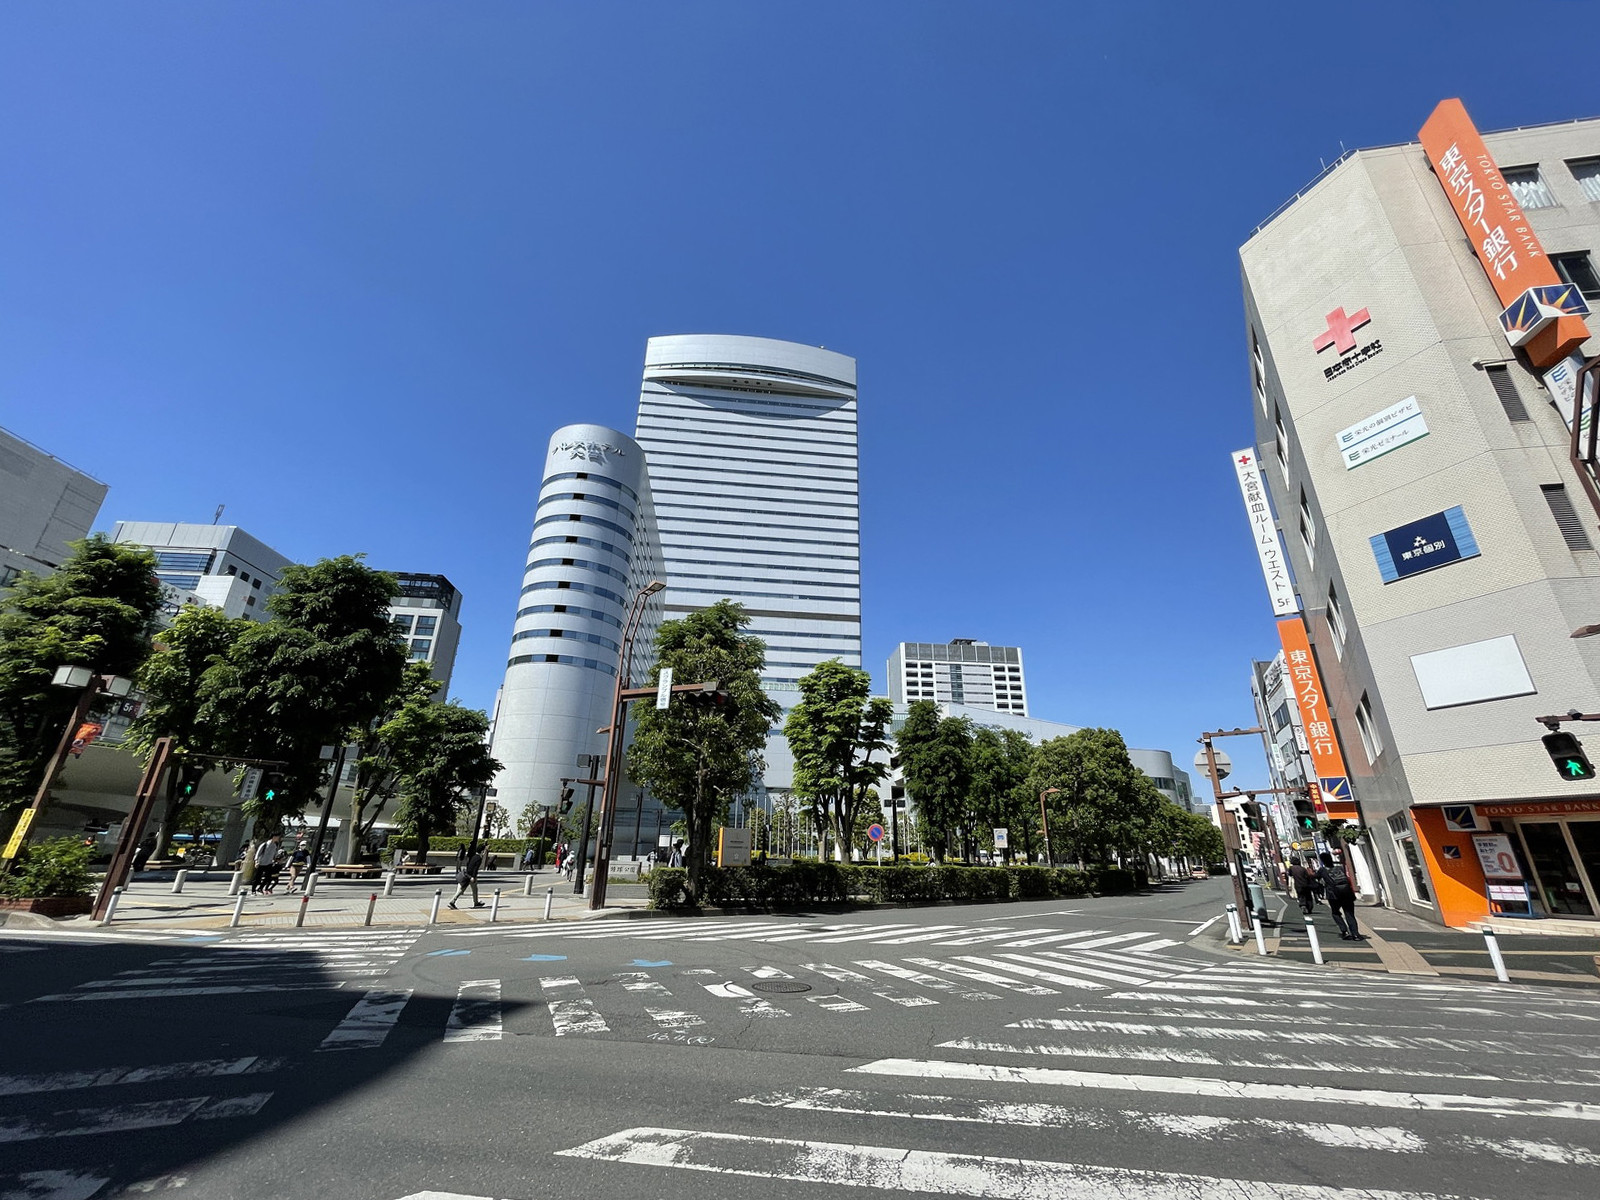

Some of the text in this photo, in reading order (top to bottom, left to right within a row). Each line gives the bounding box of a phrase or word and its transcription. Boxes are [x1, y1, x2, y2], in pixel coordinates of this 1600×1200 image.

[1439, 142, 1518, 280] 東京スター銀行
[1476, 154, 1541, 258] TOKYO STAR BANK
[1323, 339, 1382, 379] 日本赤十字社
[1354, 403, 1413, 436] 栄光の個別ビザビ
[1361, 429, 1409, 454] 栄光ゼミナール
[1242, 470, 1273, 545] 大宮献血ルーム
[1264, 549, 1286, 592] ウエスト
[1277, 598, 1291, 608] 5F
[1401, 539, 1446, 561] 東京個別
[1288, 649, 1333, 755] 東京スター銀行
[1484, 803, 1600, 815] TOKYO STAR BANK
